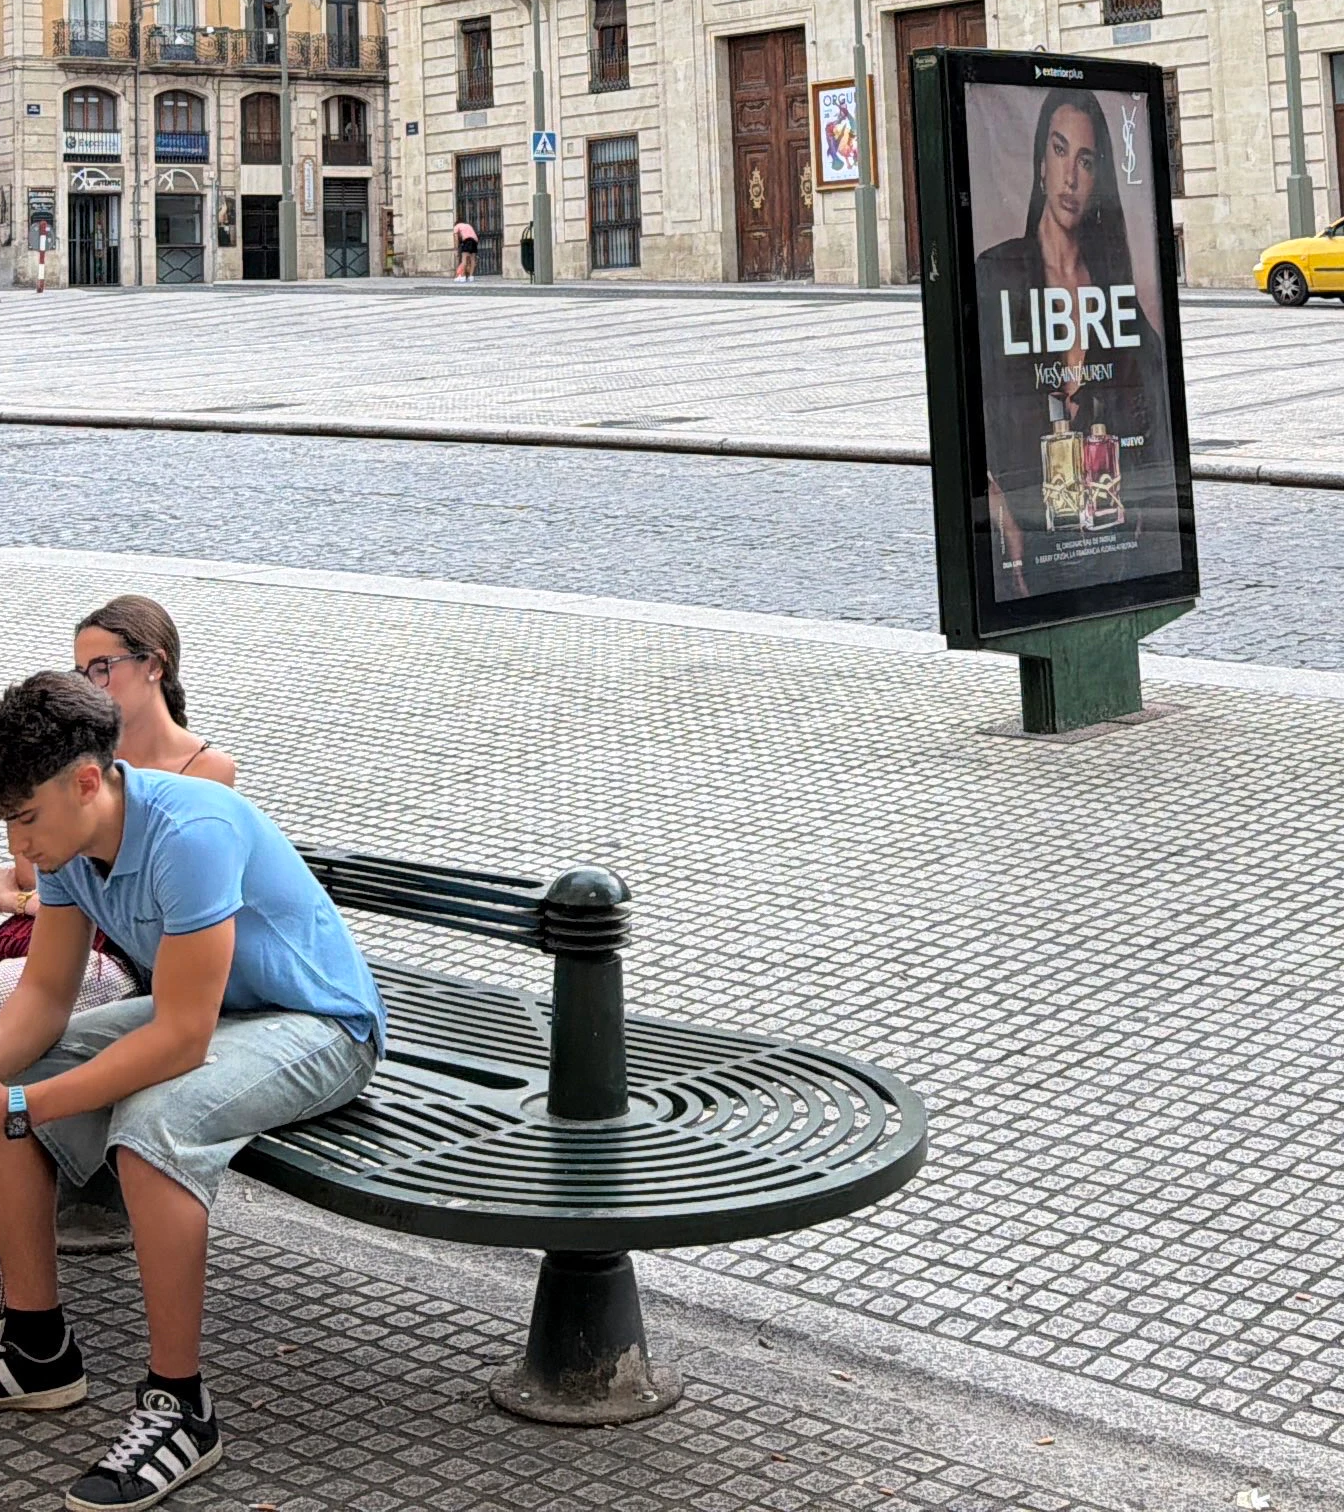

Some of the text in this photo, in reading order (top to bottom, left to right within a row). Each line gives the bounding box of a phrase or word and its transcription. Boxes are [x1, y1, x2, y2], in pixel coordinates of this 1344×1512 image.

[1042, 67, 1084, 80] exteriorplus
[823, 91, 856, 107] ORGU
[1121, 104, 1143, 184] YSL
[1000, 284, 1141, 356] LIBRE
[1120, 435, 1144, 447] NUEVO
